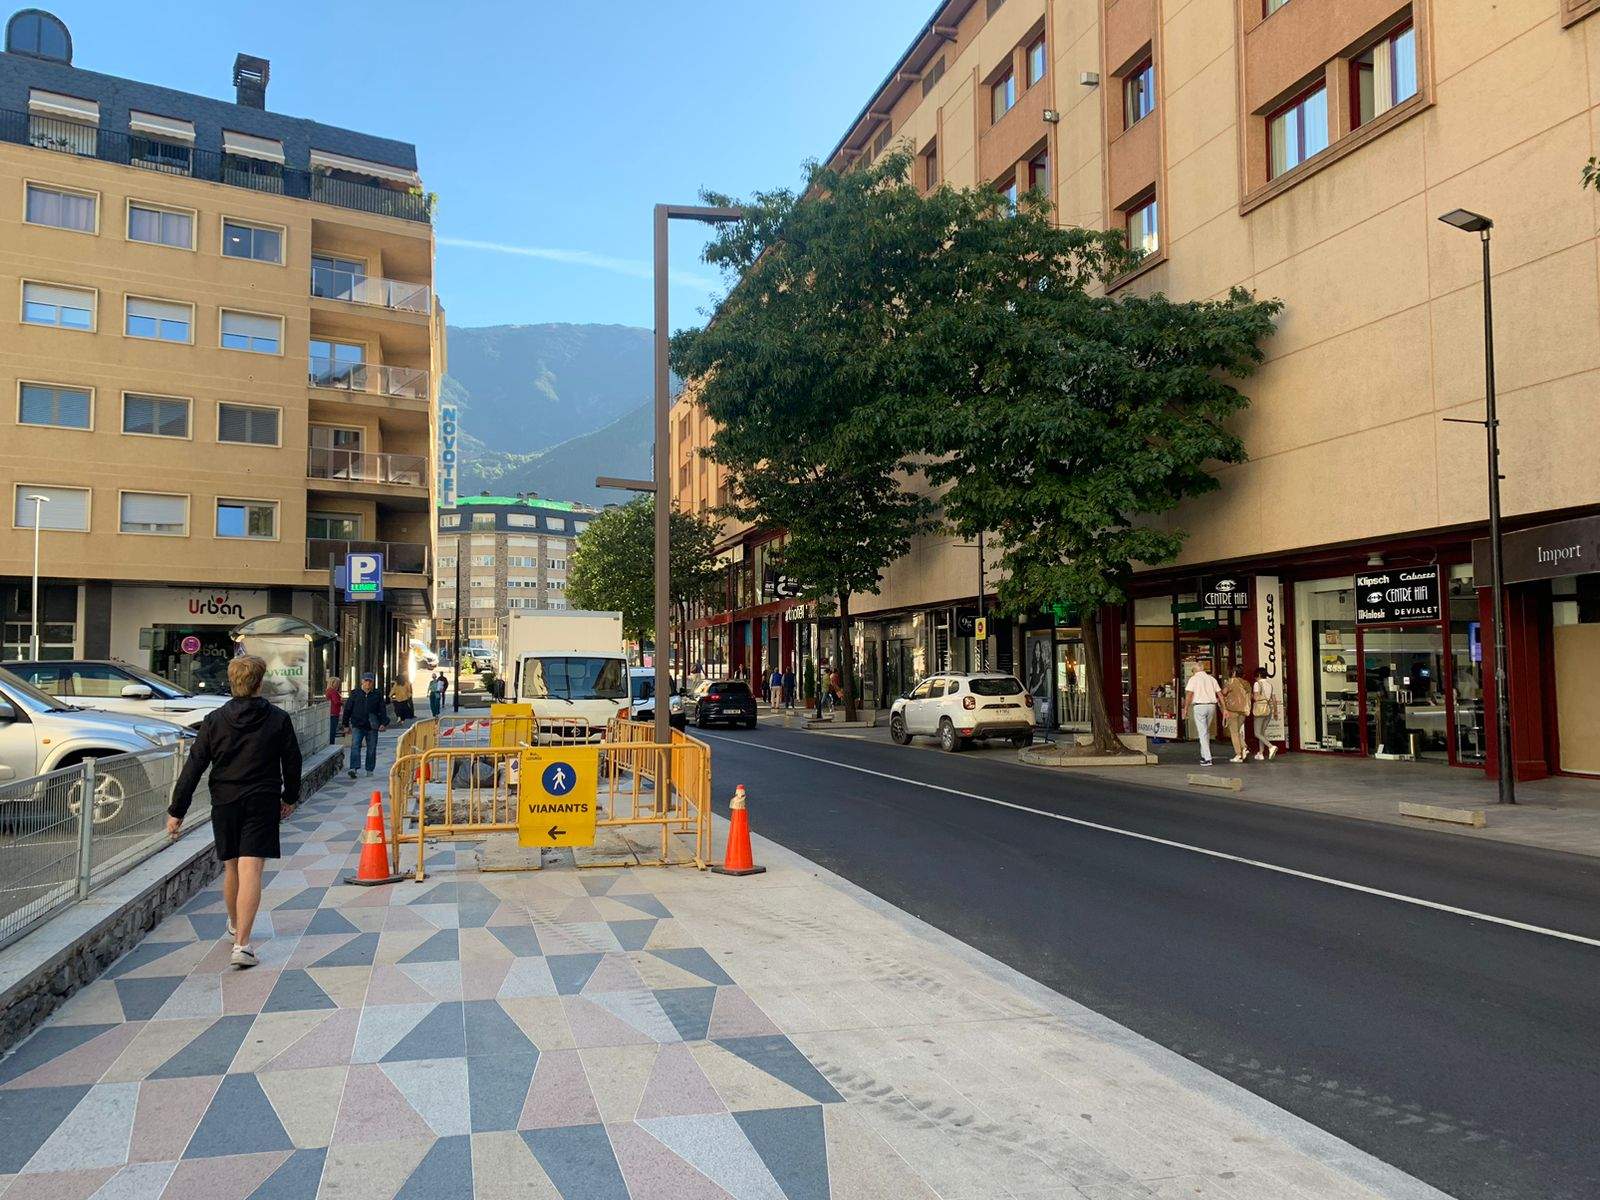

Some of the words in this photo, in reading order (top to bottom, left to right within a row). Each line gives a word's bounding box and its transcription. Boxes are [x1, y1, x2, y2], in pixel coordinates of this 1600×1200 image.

[442, 408, 456, 506] NOVOTEL
[1538, 545, 1582, 566] Import
[351, 556, 377, 584] P
[1399, 572, 1436, 581] Cabasse
[1357, 574, 1390, 587] Klipsch
[1204, 592, 1232, 605] CENTRE
[1234, 592, 1248, 605] HIFI
[1385, 587, 1412, 603] CENTRE
[1414, 585, 1429, 601] HIFI
[189, 598, 245, 619] Urban
[1394, 606, 1438, 616] DEVIALET
[529, 803, 588, 813] VIANANTS
